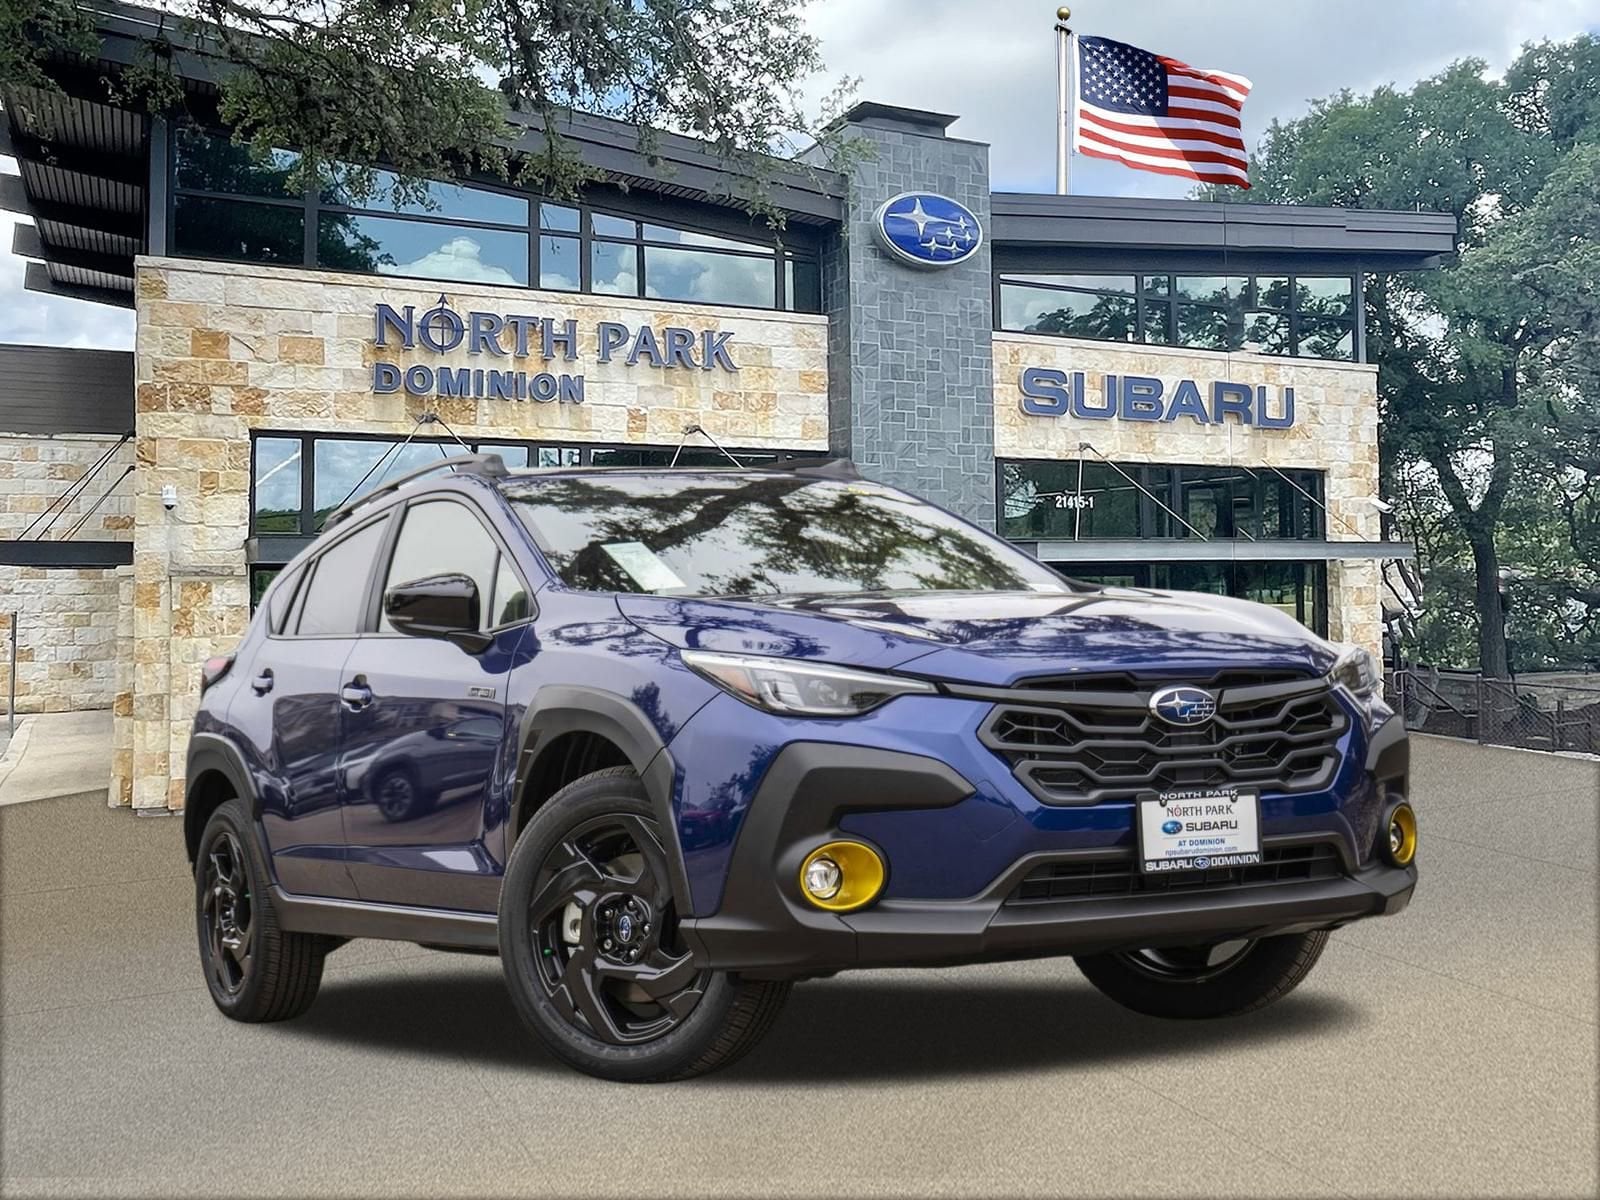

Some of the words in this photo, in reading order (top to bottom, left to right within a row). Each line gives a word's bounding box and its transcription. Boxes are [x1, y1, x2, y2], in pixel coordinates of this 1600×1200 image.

[375, 293, 579, 361] NORTH
[596, 321, 739, 372] PARK
[373, 362, 585, 404] DOMINION
[1019, 367, 1295, 430] SUBARU
[1159, 792, 1202, 800] NORTH
[1206, 789, 1238, 798] PARK
[1166, 805, 1202, 817] NORTH
[1205, 804, 1234, 816] PARK
[1185, 820, 1237, 831] SUBARU
[1178, 839, 1187, 847] AT
[1188, 837, 1226, 846] DOMINION
[1145, 858, 1193, 872] SUBARU
[1211, 853, 1260, 866] DOMINION
